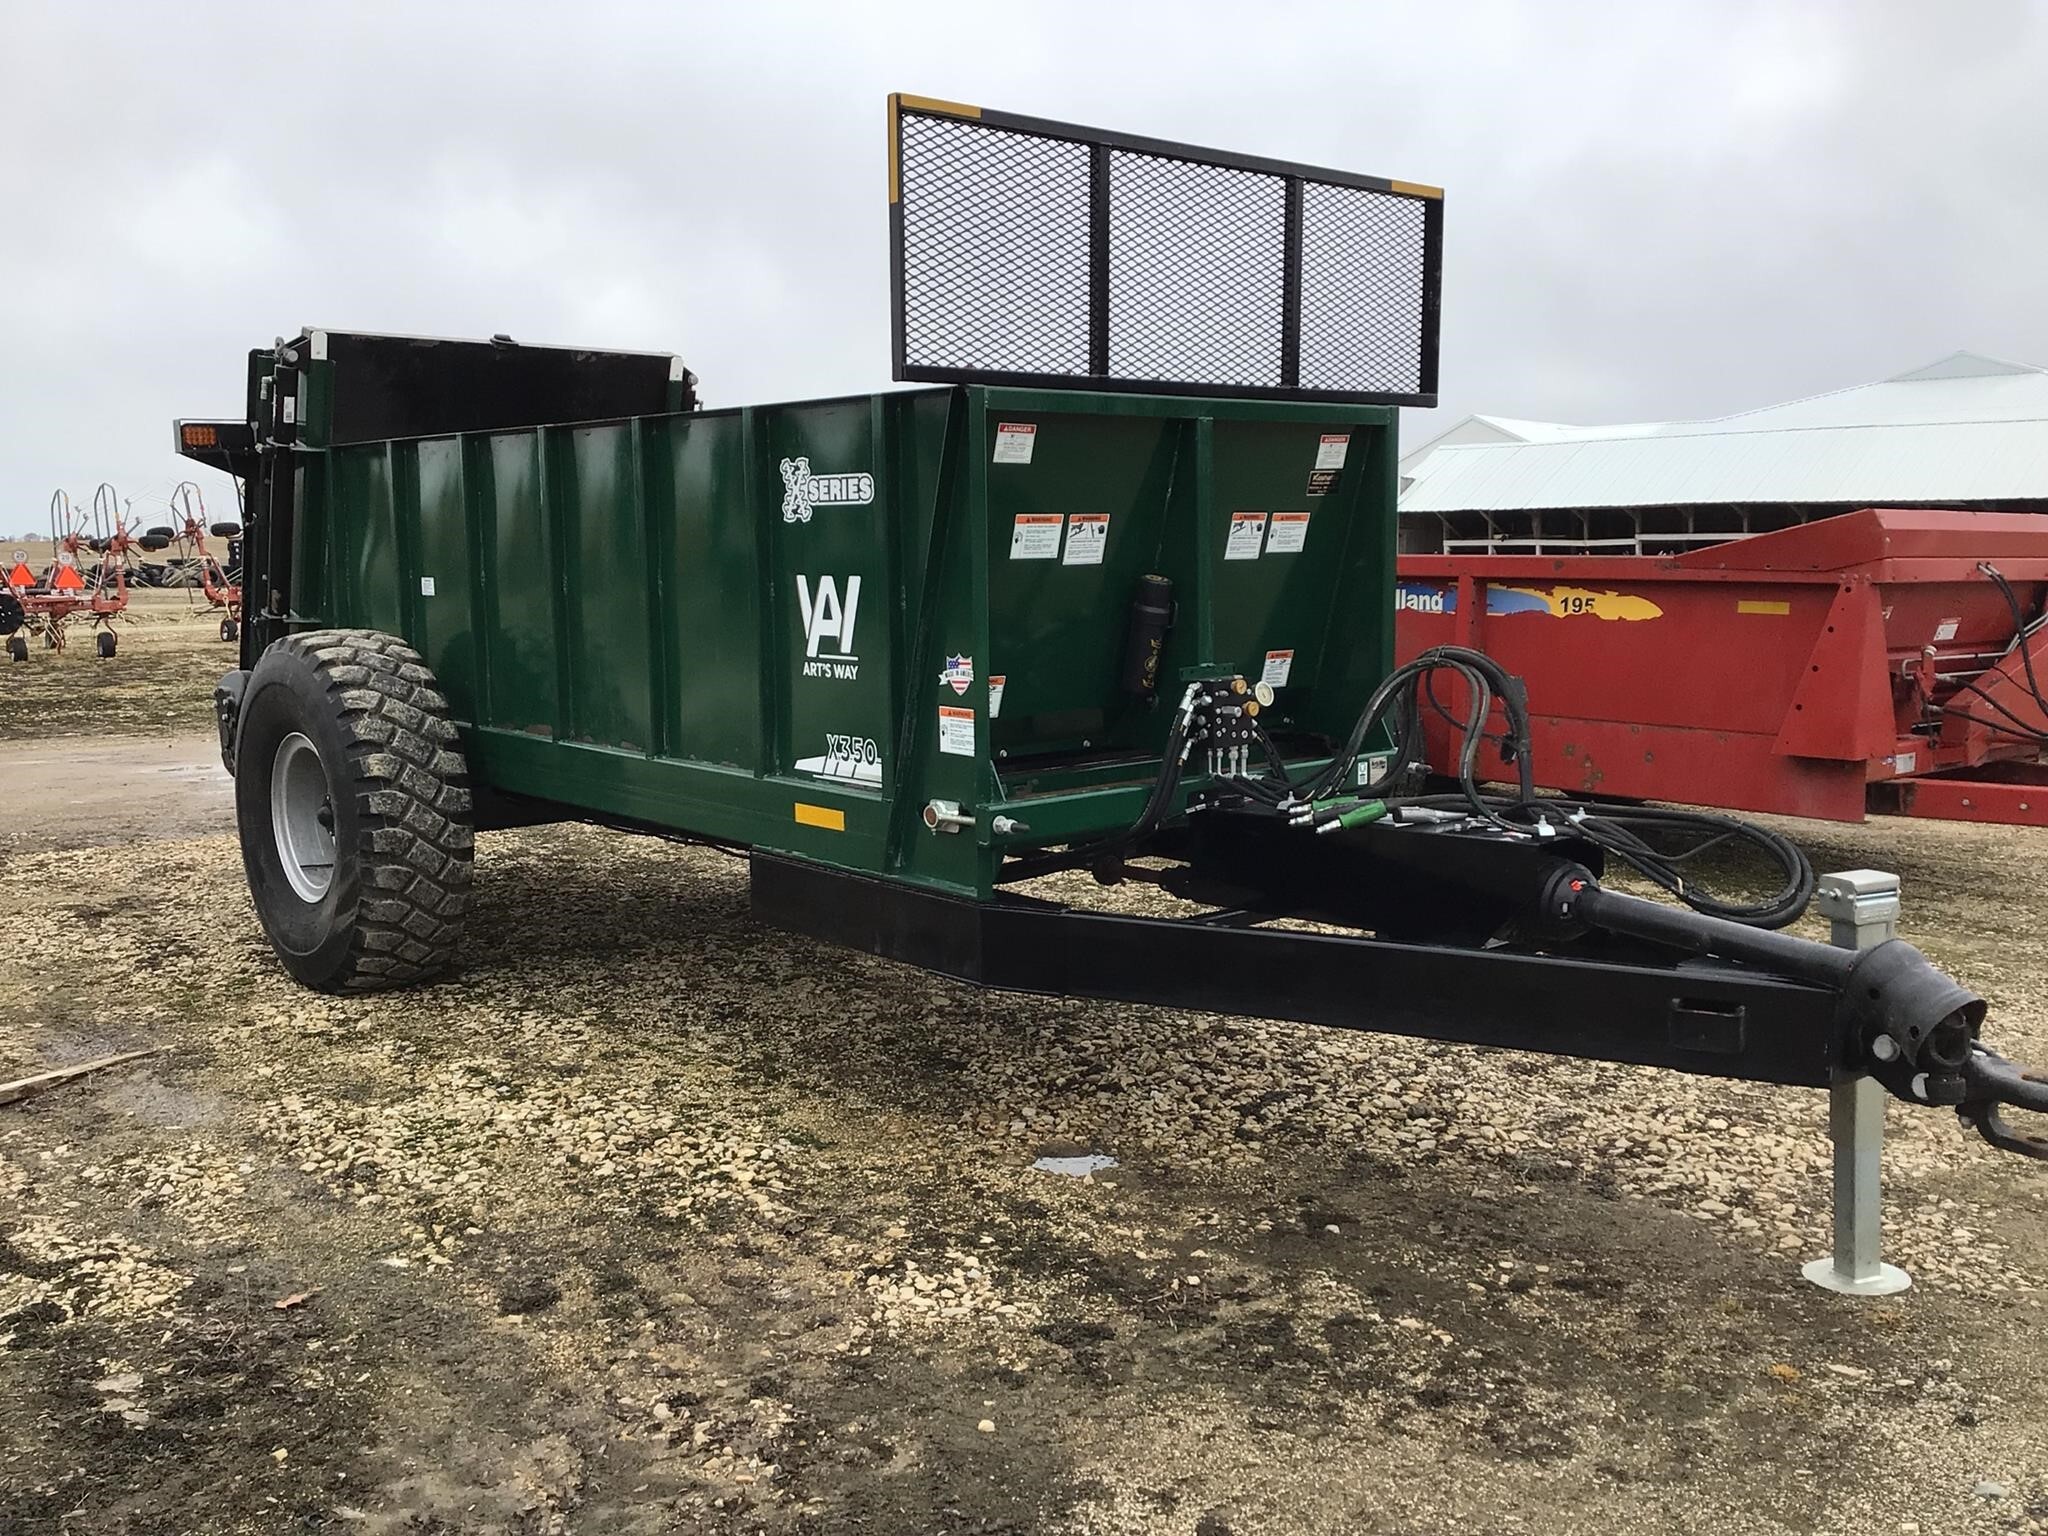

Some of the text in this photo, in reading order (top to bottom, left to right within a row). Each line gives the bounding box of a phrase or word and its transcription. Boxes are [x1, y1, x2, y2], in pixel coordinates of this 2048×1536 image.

[807, 476, 872, 502] SERIES
[1560, 596, 1596, 613] 195
[803, 661, 859, 680] ART'S WAY
[826, 733, 878, 766] X350
